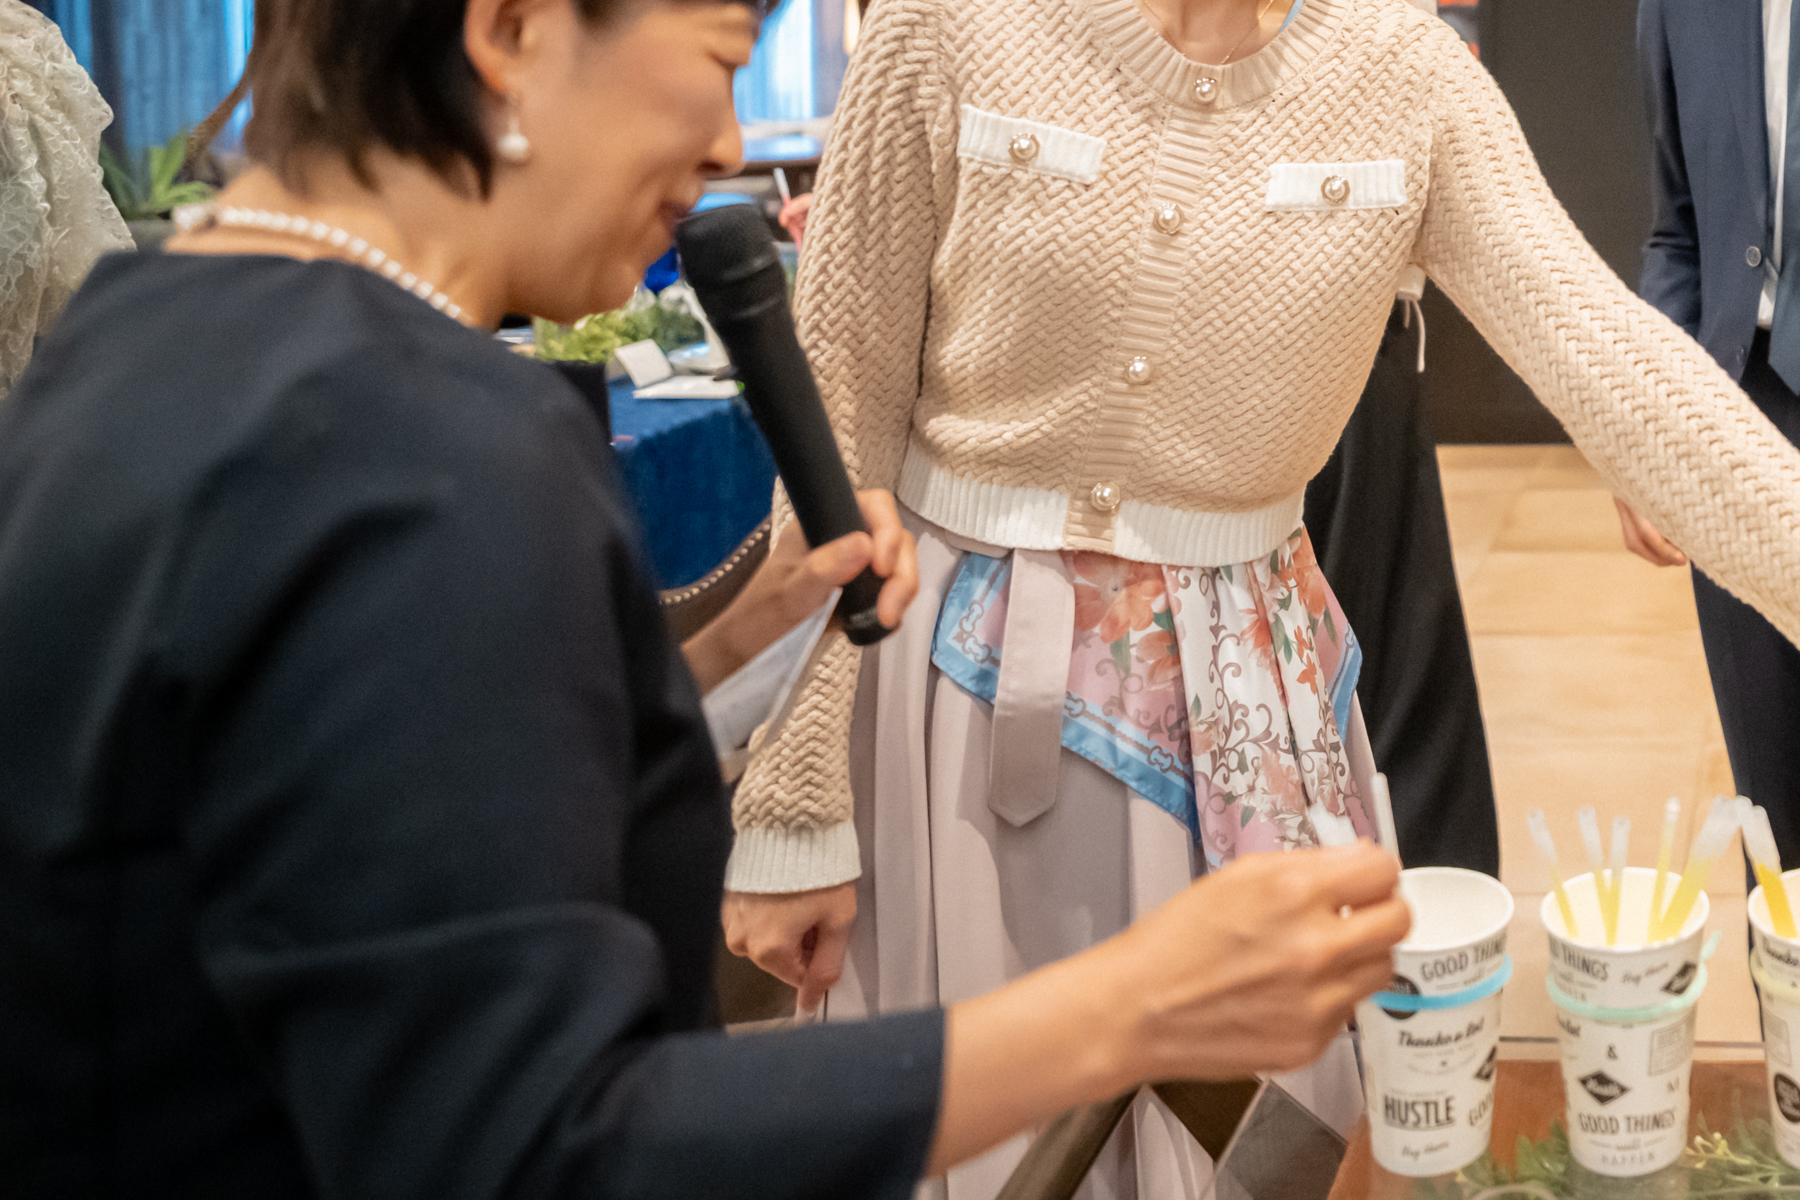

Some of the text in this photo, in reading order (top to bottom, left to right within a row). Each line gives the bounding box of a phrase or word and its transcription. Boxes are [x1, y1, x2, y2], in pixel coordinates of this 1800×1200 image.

[1421, 952, 1470, 982] GOOD
[1561, 942, 1611, 982] THINGS
[1384, 1094, 1456, 1128] HUSTLE
[1578, 1107, 1678, 1135] GOOD THINGS
